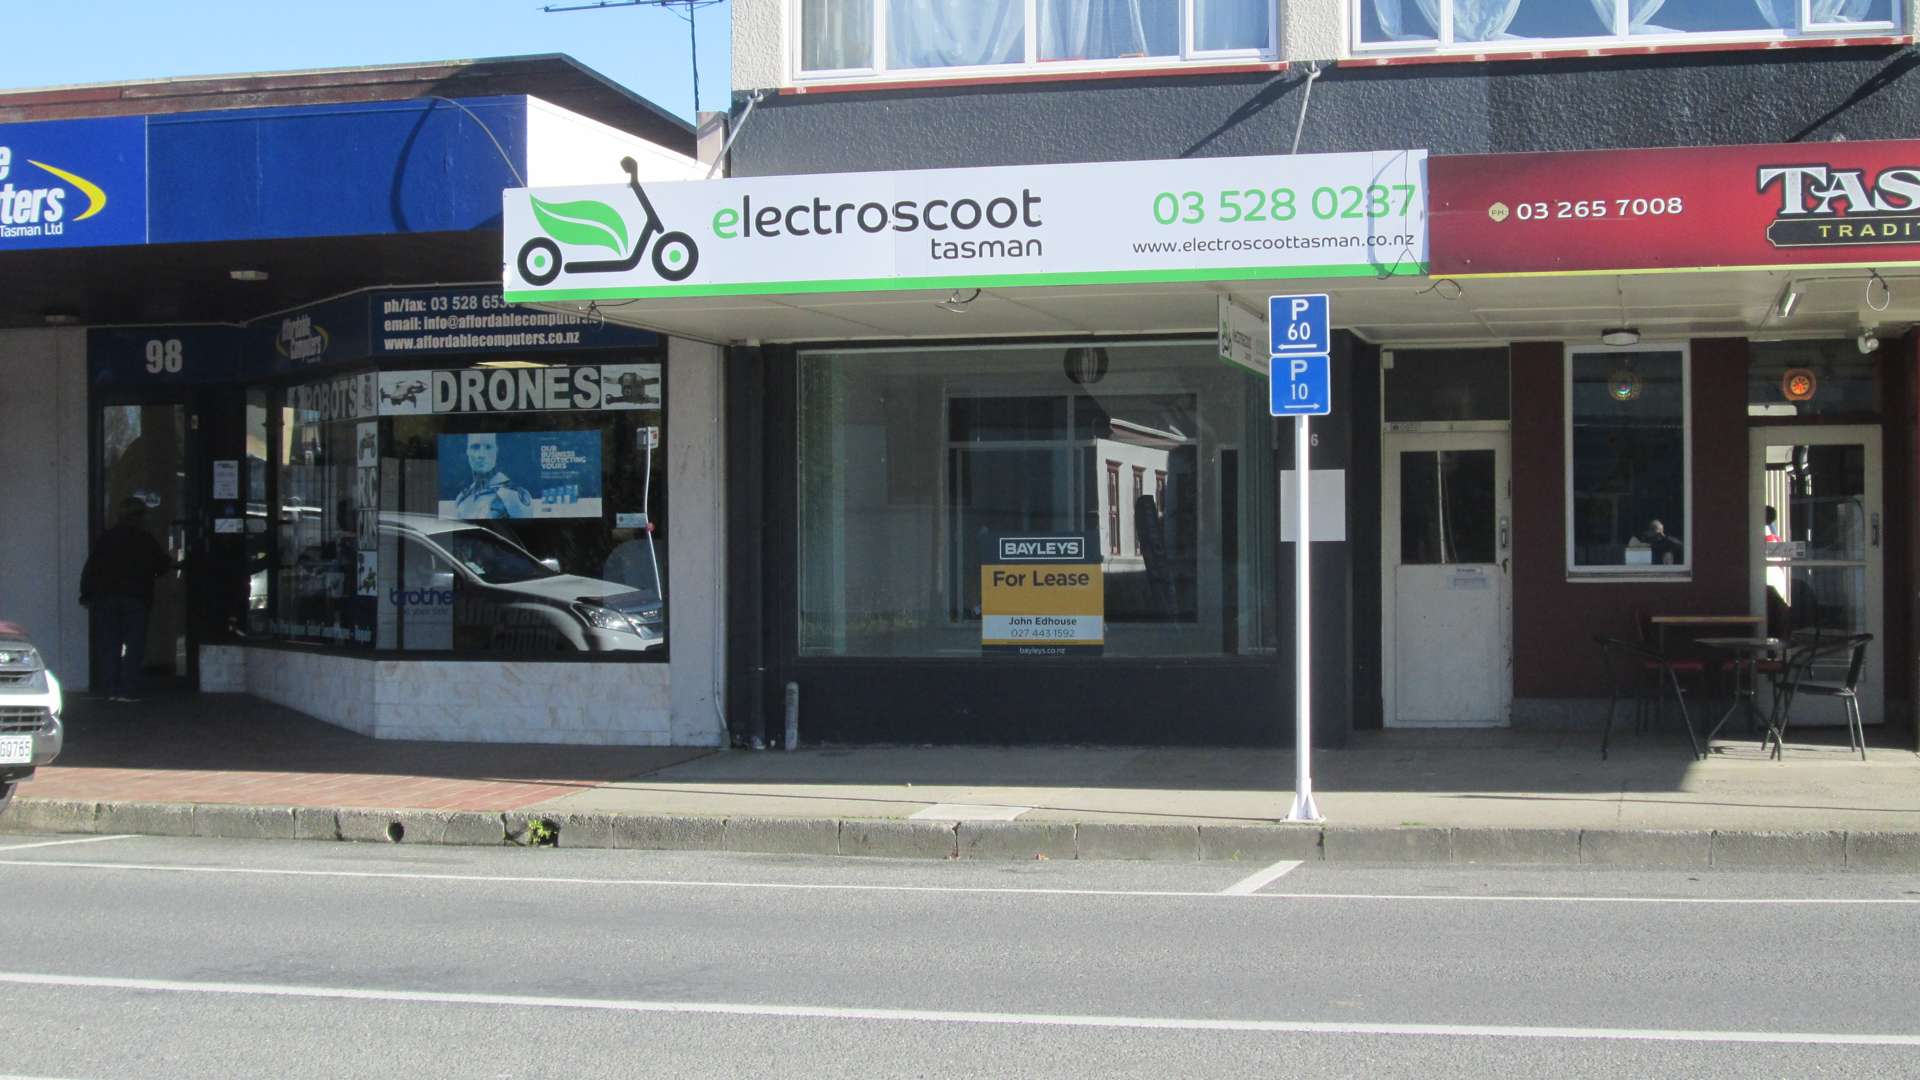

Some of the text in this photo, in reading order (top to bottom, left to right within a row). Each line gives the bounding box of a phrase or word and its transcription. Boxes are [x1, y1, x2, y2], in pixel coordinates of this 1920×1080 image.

[712, 188, 1043, 239] electroscoot
[1153, 184, 1416, 225] 03 528 0237
[1516, 203, 1549, 220] 03
[1557, 200, 1607, 218] 265
[1616, 197, 1683, 216] 7008
[0, 222, 63, 237] Tasman Ltd
[1818, 222, 1920, 238] TRADI
[931, 238, 1043, 260] tasman
[1132, 233, 1415, 253] www.electroscoottasman.co.nz
[384, 298, 426, 314] ph/fax:
[431, 297, 448, 311] 03
[452, 296, 477, 311] 528
[1291, 299, 1310, 321] P
[384, 316, 422, 332] email:
[1287, 322, 1311, 341] 60
[384, 330, 580, 350] www.affordablecomputers.co.nz
[145, 339, 183, 373] 98
[1290, 359, 1309, 382] P
[432, 367, 601, 412] DRONES
[1290, 383, 1309, 401] 10
[1005, 542, 1079, 555] BAYLEYS
[993, 570, 1090, 587] For Lease
[1008, 617, 1077, 626] John Edhouse
[1010, 628, 1075, 638] 027 443 1592
[1019, 647, 1065, 655] bayleys.co.nz
